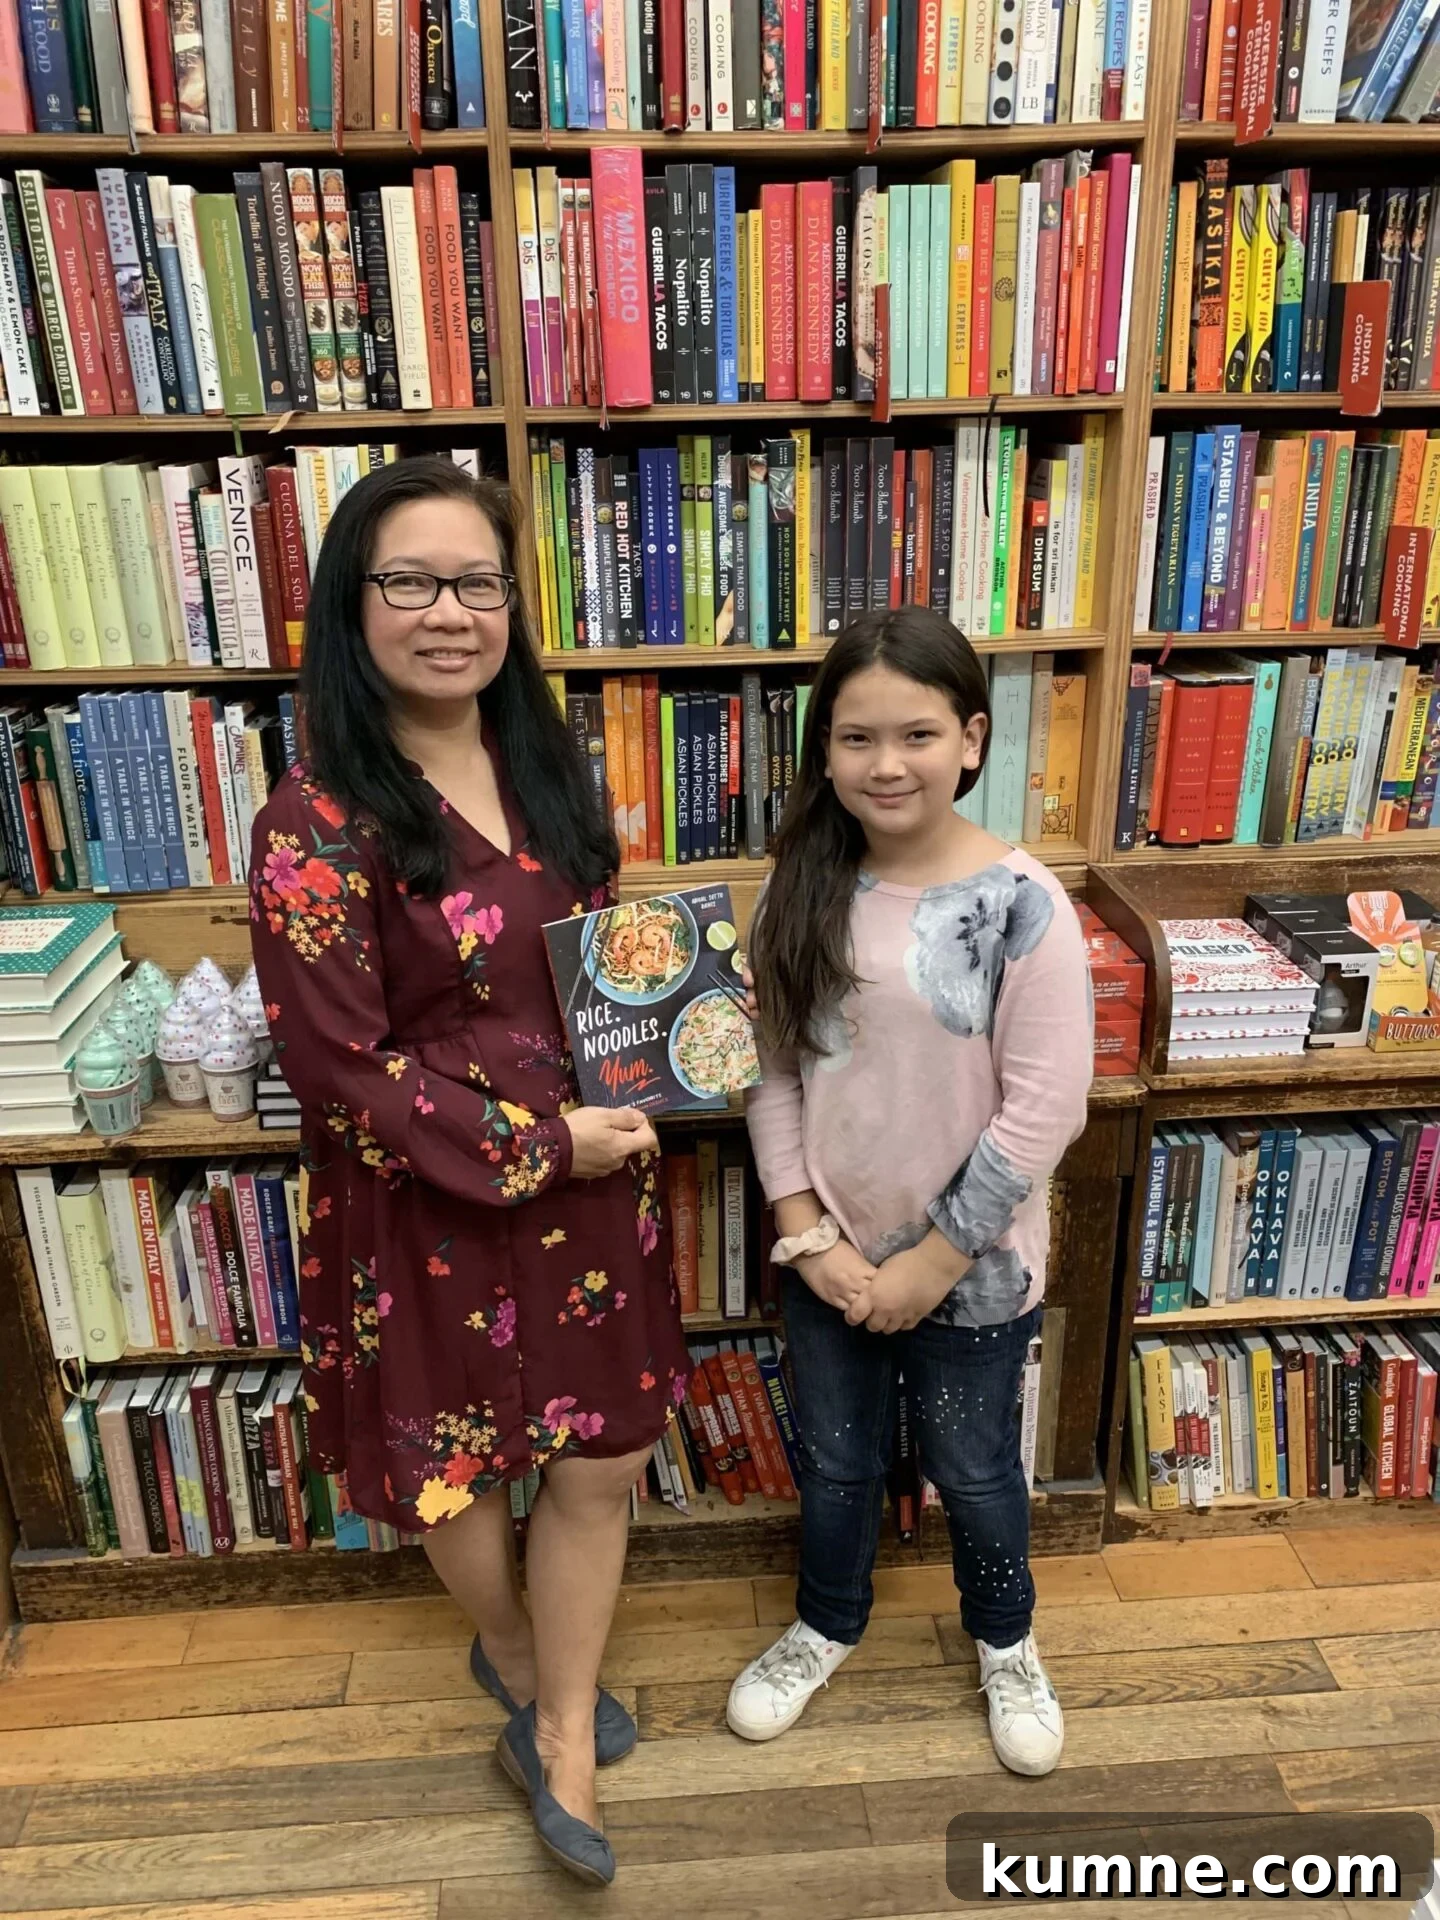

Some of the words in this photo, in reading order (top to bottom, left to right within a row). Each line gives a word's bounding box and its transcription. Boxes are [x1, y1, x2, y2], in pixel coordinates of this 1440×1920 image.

[427, 25, 443, 84] Oaxaca
[690, 17, 698, 81] COOKING
[715, 14, 725, 79] COOKING
[923, 1, 937, 75] COOKING
[947, 17, 959, 71] EXPRESS
[1112, 15, 1124, 66] RECIPES
[1321, 25, 1337, 75] CHEFS
[1383, 18, 1414, 71] GREECE
[1241, 28, 1254, 109] COOKING
[1256, 20, 1272, 106] OVERSIZE
[21, 181, 35, 214] SALT
[247, 196, 262, 239] Tortellini
[270, 181, 287, 237] NUOVO
[718, 176, 730, 220] TURNIP
[29, 216, 40, 233] TO
[253, 239, 261, 253] at
[424, 226, 436, 265] FOOD
[444, 224, 457, 264] FOOD
[770, 219, 783, 274] DIANA
[807, 219, 820, 275] DIANA
[1204, 187, 1225, 289] RASIKA
[31, 235, 49, 277] TASTE
[278, 241, 295, 298] MONDO
[302, 265, 322, 273] NOW
[567, 236, 576, 274] BRAZILIAN
[617, 211, 639, 323] MEXICO
[652, 226, 665, 302] GUERRILLA
[719, 224, 731, 272] GREENS
[821, 242, 831, 298] MEXICAN
[835, 226, 846, 299] GUERRILLA
[255, 256, 270, 300] Midnight
[303, 273, 324, 282] EAT
[427, 270, 440, 302] YOU
[447, 269, 459, 299] YOU
[569, 275, 577, 309] KITCHEN
[672, 258, 690, 326] Nopalito
[696, 257, 713, 326] Nopalito
[719, 277, 732, 292] &
[784, 244, 796, 298] MEXICAN
[957, 265, 967, 298] CHINA
[431, 304, 443, 343] WANT
[449, 302, 463, 342] WANT
[654, 305, 667, 350] TACOS
[719, 296, 732, 355] TORTILLAS
[770, 279, 785, 365] KENNEDY
[785, 300, 796, 365] COOKING
[808, 279, 820, 365] KENNEDY
[821, 301, 832, 365] COOKING
[835, 302, 846, 347] TACOS
[955, 303, 966, 351] EXPRESS
[44, 299, 61, 340] MARCO
[53, 341, 72, 392] CANORA
[1351, 314, 1364, 384] COOKING
[1360, 322, 1373, 376] INDIAN
[1001, 436, 1011, 480] STONED
[1216, 434, 1236, 508] ISTANBUL
[615, 501, 628, 530] RED
[961, 472, 971, 529] Vietnamese
[1146, 472, 1159, 519] PRASHAD
[1171, 474, 1184, 517] INDIAN
[1216, 512, 1228, 522] &
[1302, 482, 1321, 532] INDIA
[226, 469, 252, 572] VENICE
[602, 534, 611, 565] SIMPLE
[617, 533, 630, 560] HOT
[700, 530, 711, 570] SIMPLY
[736, 532, 744, 562] SIMPLE
[960, 531, 969, 560] Home
[1032, 538, 1044, 565] DIM
[1167, 517, 1182, 586] VEGETARIAN
[1210, 526, 1227, 584] BEYOND
[604, 567, 613, 588] THAI
[618, 563, 633, 619] KITCHEN
[701, 573, 713, 597] PHO
[736, 565, 744, 585] THAI
[956, 561, 968, 602] Cooking
[1031, 565, 1043, 591] SUM
[1050, 560, 1058, 593] lankan
[1392, 554, 1406, 618] COOKING
[1398, 532, 1418, 641] INTERNATIONAL
[605, 590, 614, 614] FOOD
[736, 587, 745, 611] FOOD
[747, 684, 758, 737] VEGETARIAN
[1300, 678, 1318, 737] BRAISE
[678, 737, 686, 774] ASIAN
[693, 735, 701, 771] ASIAN
[707, 733, 716, 769] ASIAN
[1405, 697, 1426, 771] MEDITERRANEAN
[117, 767, 129, 794] TABLE
[123, 811, 136, 841] VENICE
[158, 763, 170, 790] TABLE
[165, 806, 177, 837] VENICE
[177, 748, 191, 794] FLOUR
[185, 803, 199, 848] WATER
[678, 777, 688, 828] PICKLES
[693, 774, 702, 825] PICKLES
[707, 773, 716, 823] PICKLES
[1168, 944, 1252, 956] POLSKA
[576, 1002, 621, 1035] RICE.
[583, 1018, 668, 1062] NOODLES.
[1385, 1023, 1439, 1041] BUTTONS
[599, 1056, 654, 1097] Yum.
[1148, 1156, 1165, 1216] ISTANBUL
[1376, 1151, 1393, 1198] BOTTOM
[1397, 1166, 1411, 1195] WORLD
[1406, 1150, 1434, 1220] ETHIOPIA
[137, 1190, 153, 1225] MADE
[239, 1188, 252, 1226] MADE
[1146, 1219, 1158, 1227] &
[1247, 1170, 1270, 1260] OKLAVA
[1267, 1171, 1290, 1260] OKLAVA
[1393, 1194, 1405, 1214] CLASS
[143, 1227, 155, 1245] IN
[243, 1228, 256, 1243] IN
[1386, 1214, 1401, 1245] SWEDISH
[145, 1247, 161, 1276] ITALY
[225, 1251, 238, 1282] DOLCE
[249, 1244, 264, 1274] ITALY
[1141, 1231, 1157, 1277] BEYOND
[1379, 1246, 1394, 1277] COOKING
[231, 1282, 247, 1328] FAMIGLIA
[767, 1377, 789, 1416] NIKKEI
[781, 1417, 794, 1442] CUISINE
[1155, 1358, 1166, 1424] FEAST
[1346, 1382, 1361, 1434] ZAITOUN
[704, 1405, 724, 1446] JAPANESE
[722, 1393, 742, 1435] JAPANESE
[1383, 1404, 1397, 1441] GLOBAL
[1380, 1441, 1395, 1480] KITCHEN
